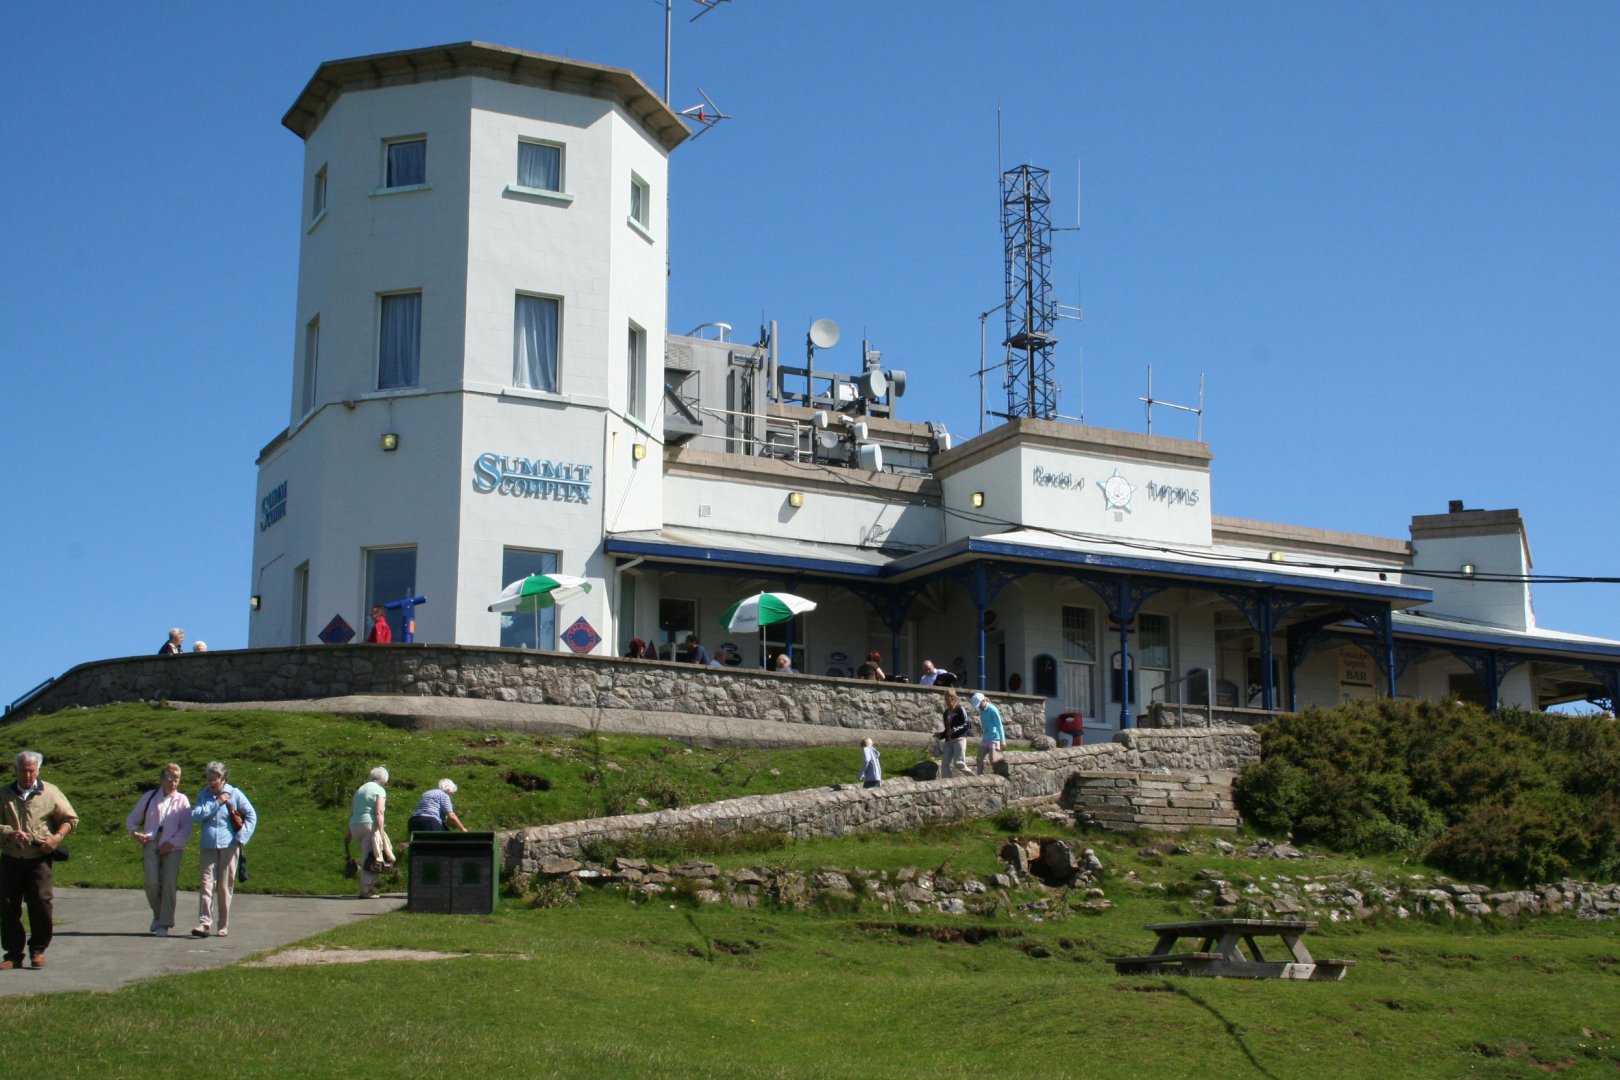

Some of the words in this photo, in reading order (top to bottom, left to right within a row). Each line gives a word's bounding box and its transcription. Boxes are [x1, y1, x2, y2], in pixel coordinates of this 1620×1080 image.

[474, 452, 593, 491] SUMMIT
[499, 478, 592, 502] COMPLEX
[1346, 671, 1368, 681] BAR
